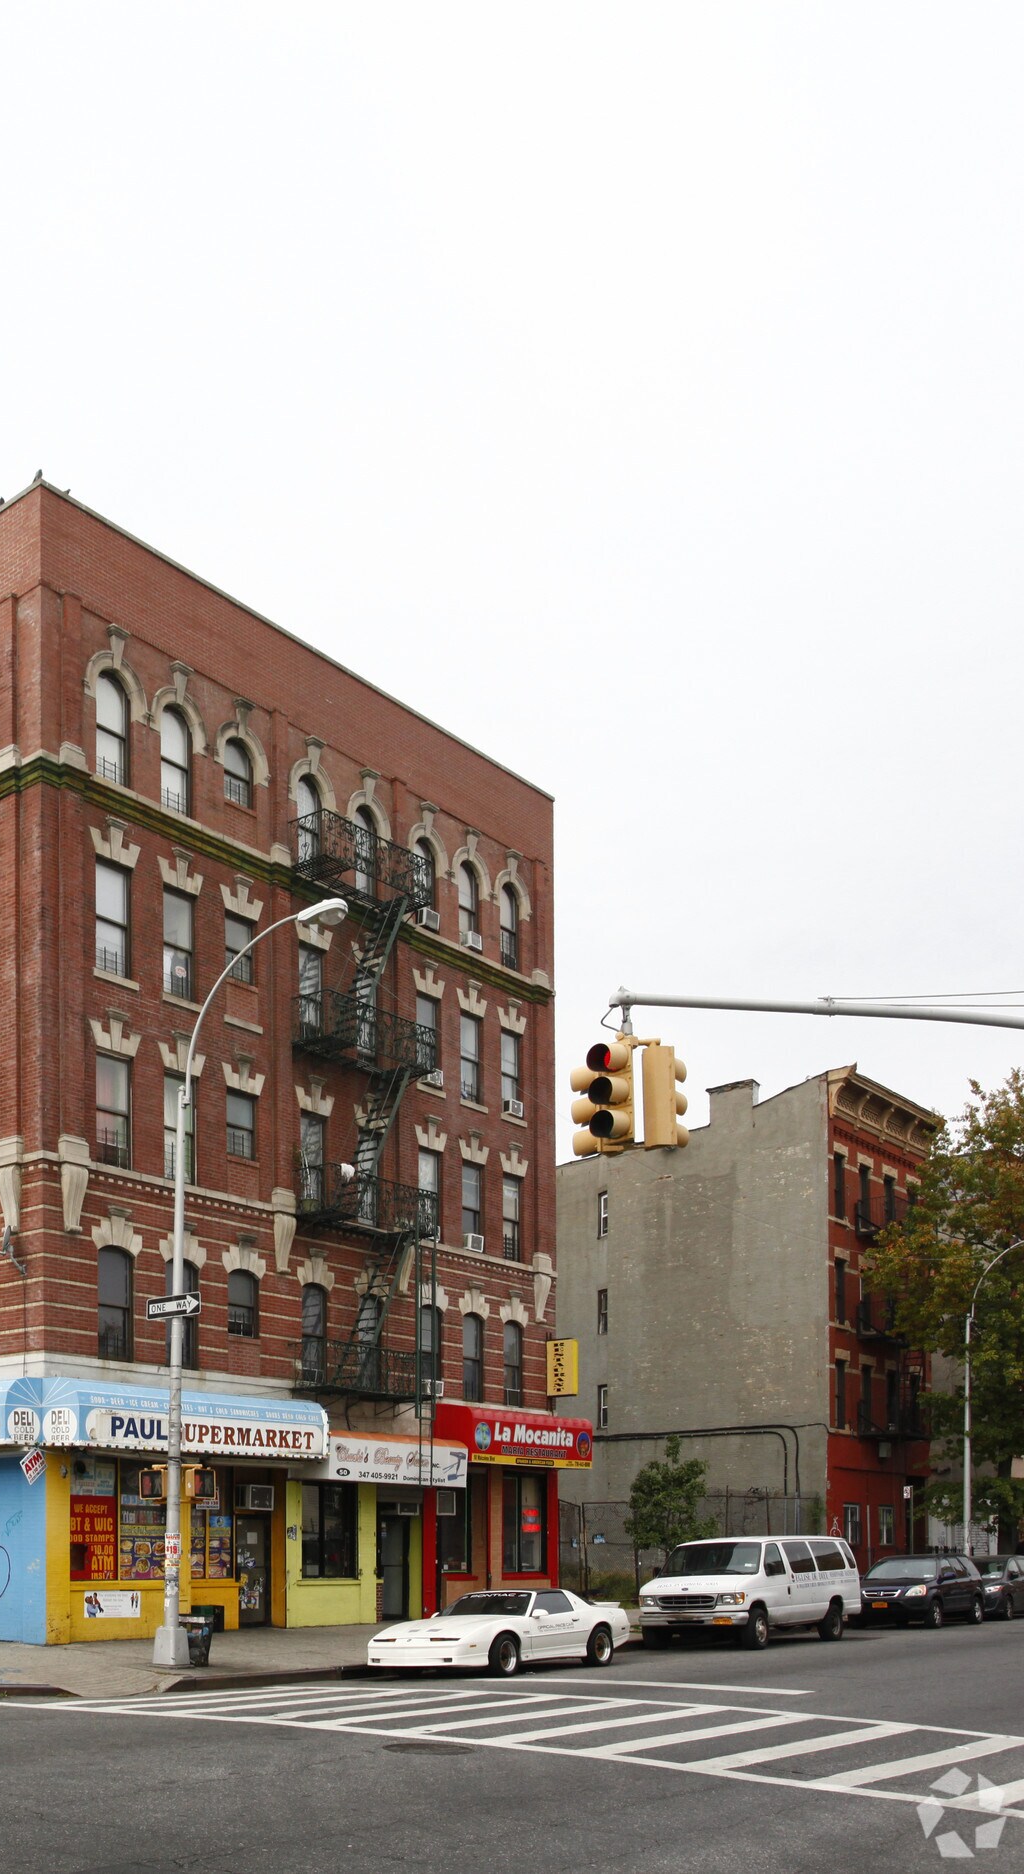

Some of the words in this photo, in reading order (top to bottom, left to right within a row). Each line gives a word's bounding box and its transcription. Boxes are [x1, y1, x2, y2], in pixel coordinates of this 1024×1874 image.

[151, 1304, 166, 1313] ONE
[176, 1300, 192, 1309] WAY
[90, 1395, 106, 1404] SODA
[110, 1397, 125, 1405] BEER
[129, 1399, 138, 1407] ICE
[141, 1399, 159, 1408] CREAM
[215, 1407, 227, 1415] COLD
[13, 1410, 34, 1426] DELI
[51, 1408, 71, 1425] DELI
[14, 1426, 34, 1434] COLD
[14, 1433, 34, 1441] BEER
[51, 1426, 70, 1434] COLD
[111, 1416, 168, 1440] PAUL
[180, 1422, 314, 1449] UPERMARKET
[494, 1422, 511, 1442] La
[513, 1423, 574, 1447] Mocanita
[501, 1445, 524, 1455] MARIA
[525, 1446, 567, 1459] RESTAURANT
[25, 1451, 43, 1474] ATM
[370, 1472, 398, 1480] 405-9921
[74, 1504, 84, 1513] WE
[85, 1504, 108, 1514] ACCEPT
[70, 1517, 82, 1531] BT
[84, 1517, 90, 1531] &
[94, 1517, 113, 1531] WIC
[85, 1534, 115, 1542] STAMPS
[91, 1545, 114, 1555] $10.00
[91, 1556, 114, 1570] ATM
